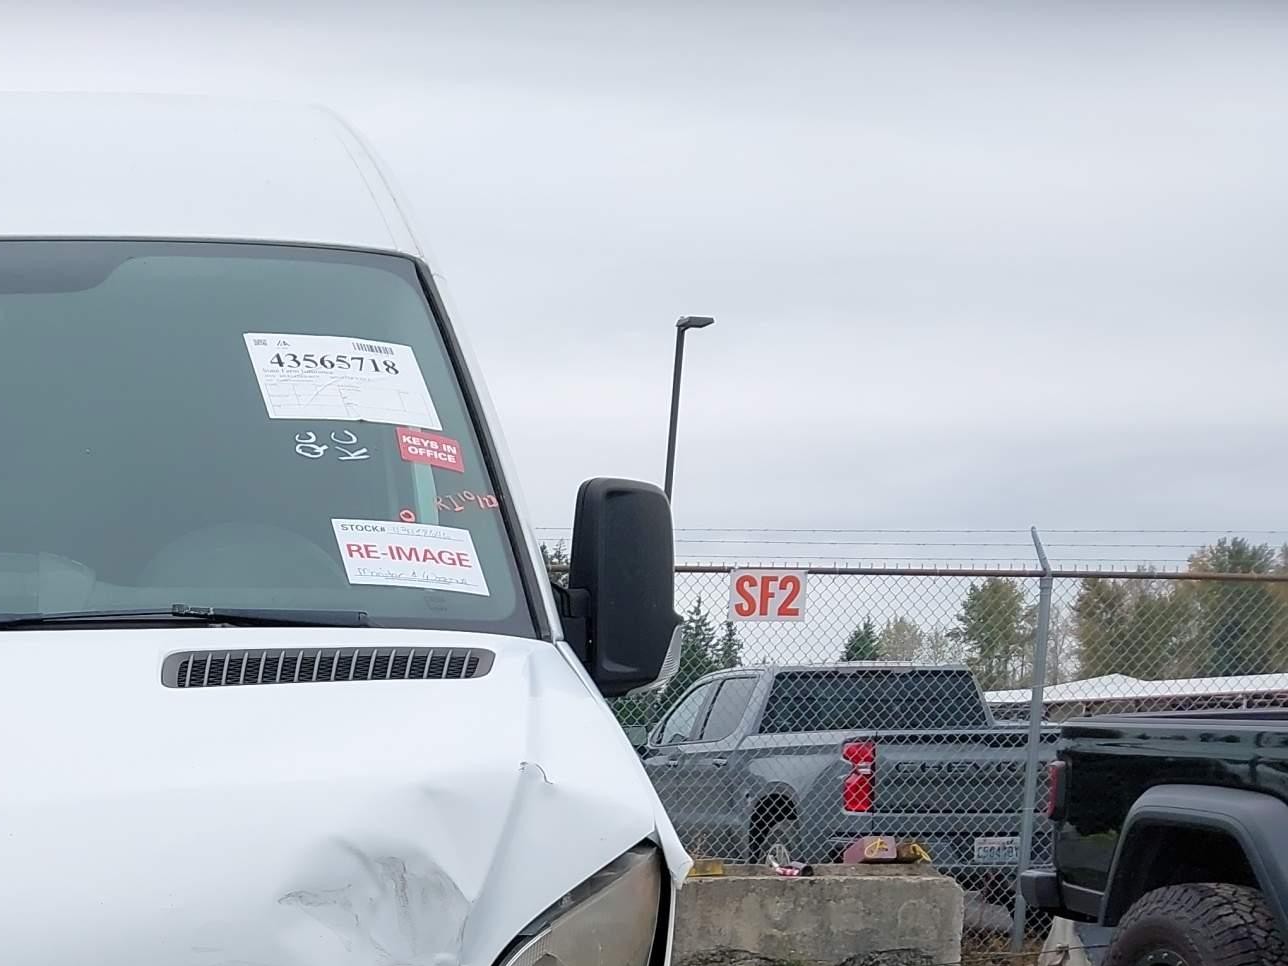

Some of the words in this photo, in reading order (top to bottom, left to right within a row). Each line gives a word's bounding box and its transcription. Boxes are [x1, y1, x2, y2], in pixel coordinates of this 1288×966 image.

[269, 352, 400, 376] 43565718
[402, 435, 439, 449] KEYS
[442, 443, 457, 454] IN
[407, 445, 457, 463] OFFICE
[340, 523, 386, 533] STOCK#
[346, 543, 473, 568] RE-IMAGE
[734, 574, 801, 617] SF2
